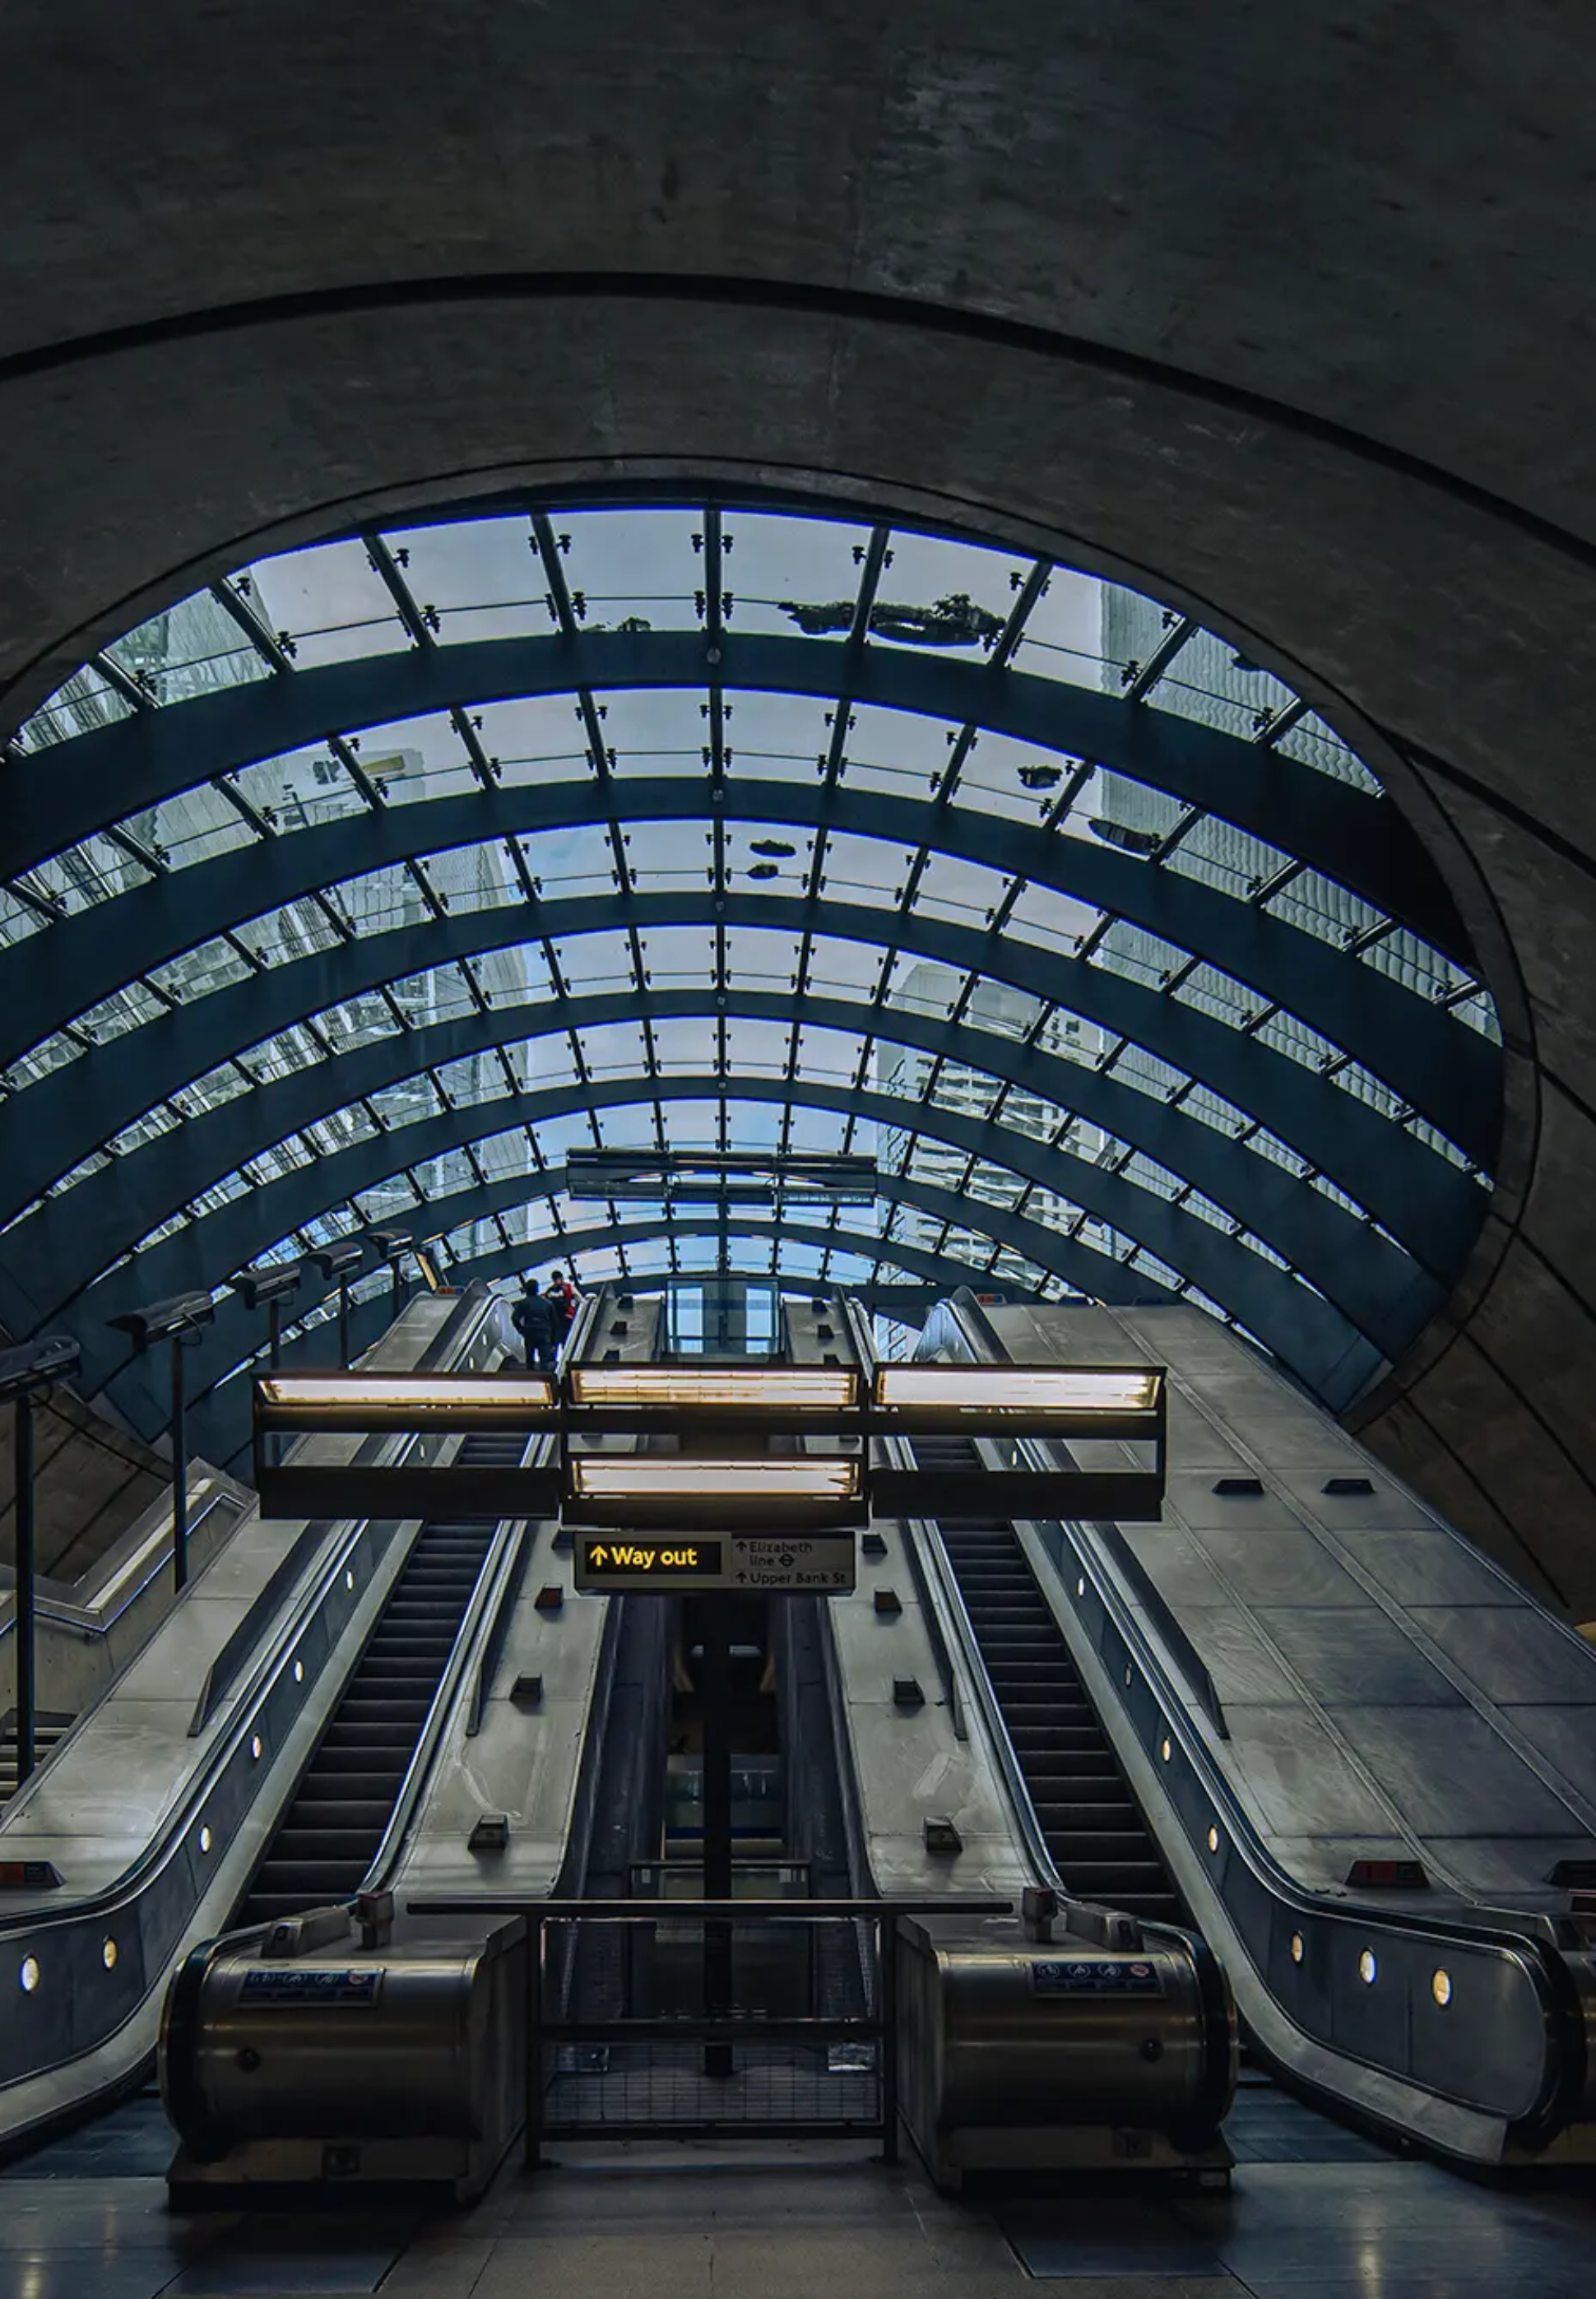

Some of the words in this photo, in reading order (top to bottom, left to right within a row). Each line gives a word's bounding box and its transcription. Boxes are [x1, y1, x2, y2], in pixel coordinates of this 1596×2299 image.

[749, 1541, 812, 1553] Elizabeth
[611, 1546, 656, 1569] Way
[661, 1548, 698, 1566] out
[750, 1555, 774, 1567] line
[750, 1572, 791, 1586] Upper
[796, 1572, 828, 1584] Bank
[833, 1572, 845, 1584] St
